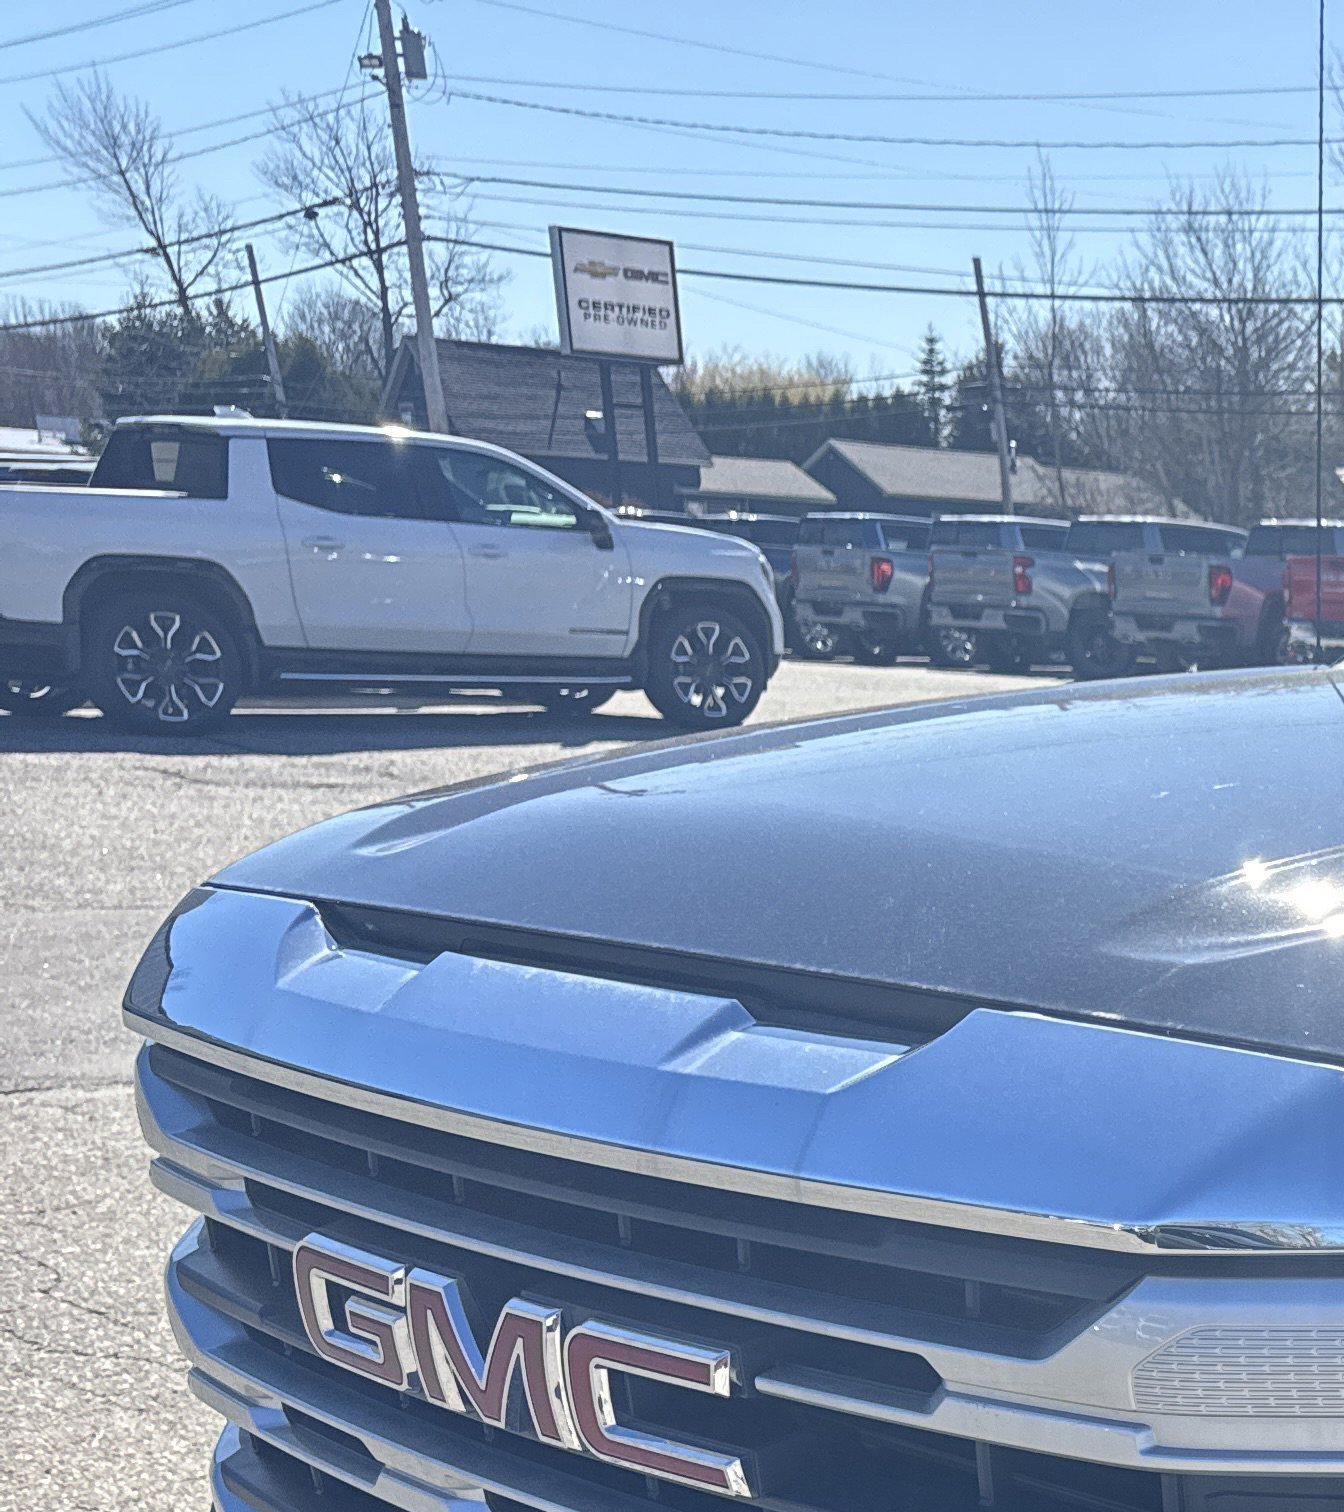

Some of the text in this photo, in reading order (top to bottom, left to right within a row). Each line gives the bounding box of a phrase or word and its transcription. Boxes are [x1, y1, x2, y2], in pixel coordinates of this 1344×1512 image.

[622, 267, 669, 285] GMC
[578, 298, 671, 320] CERTIFIED
[293, 1232, 752, 1499] GMC
